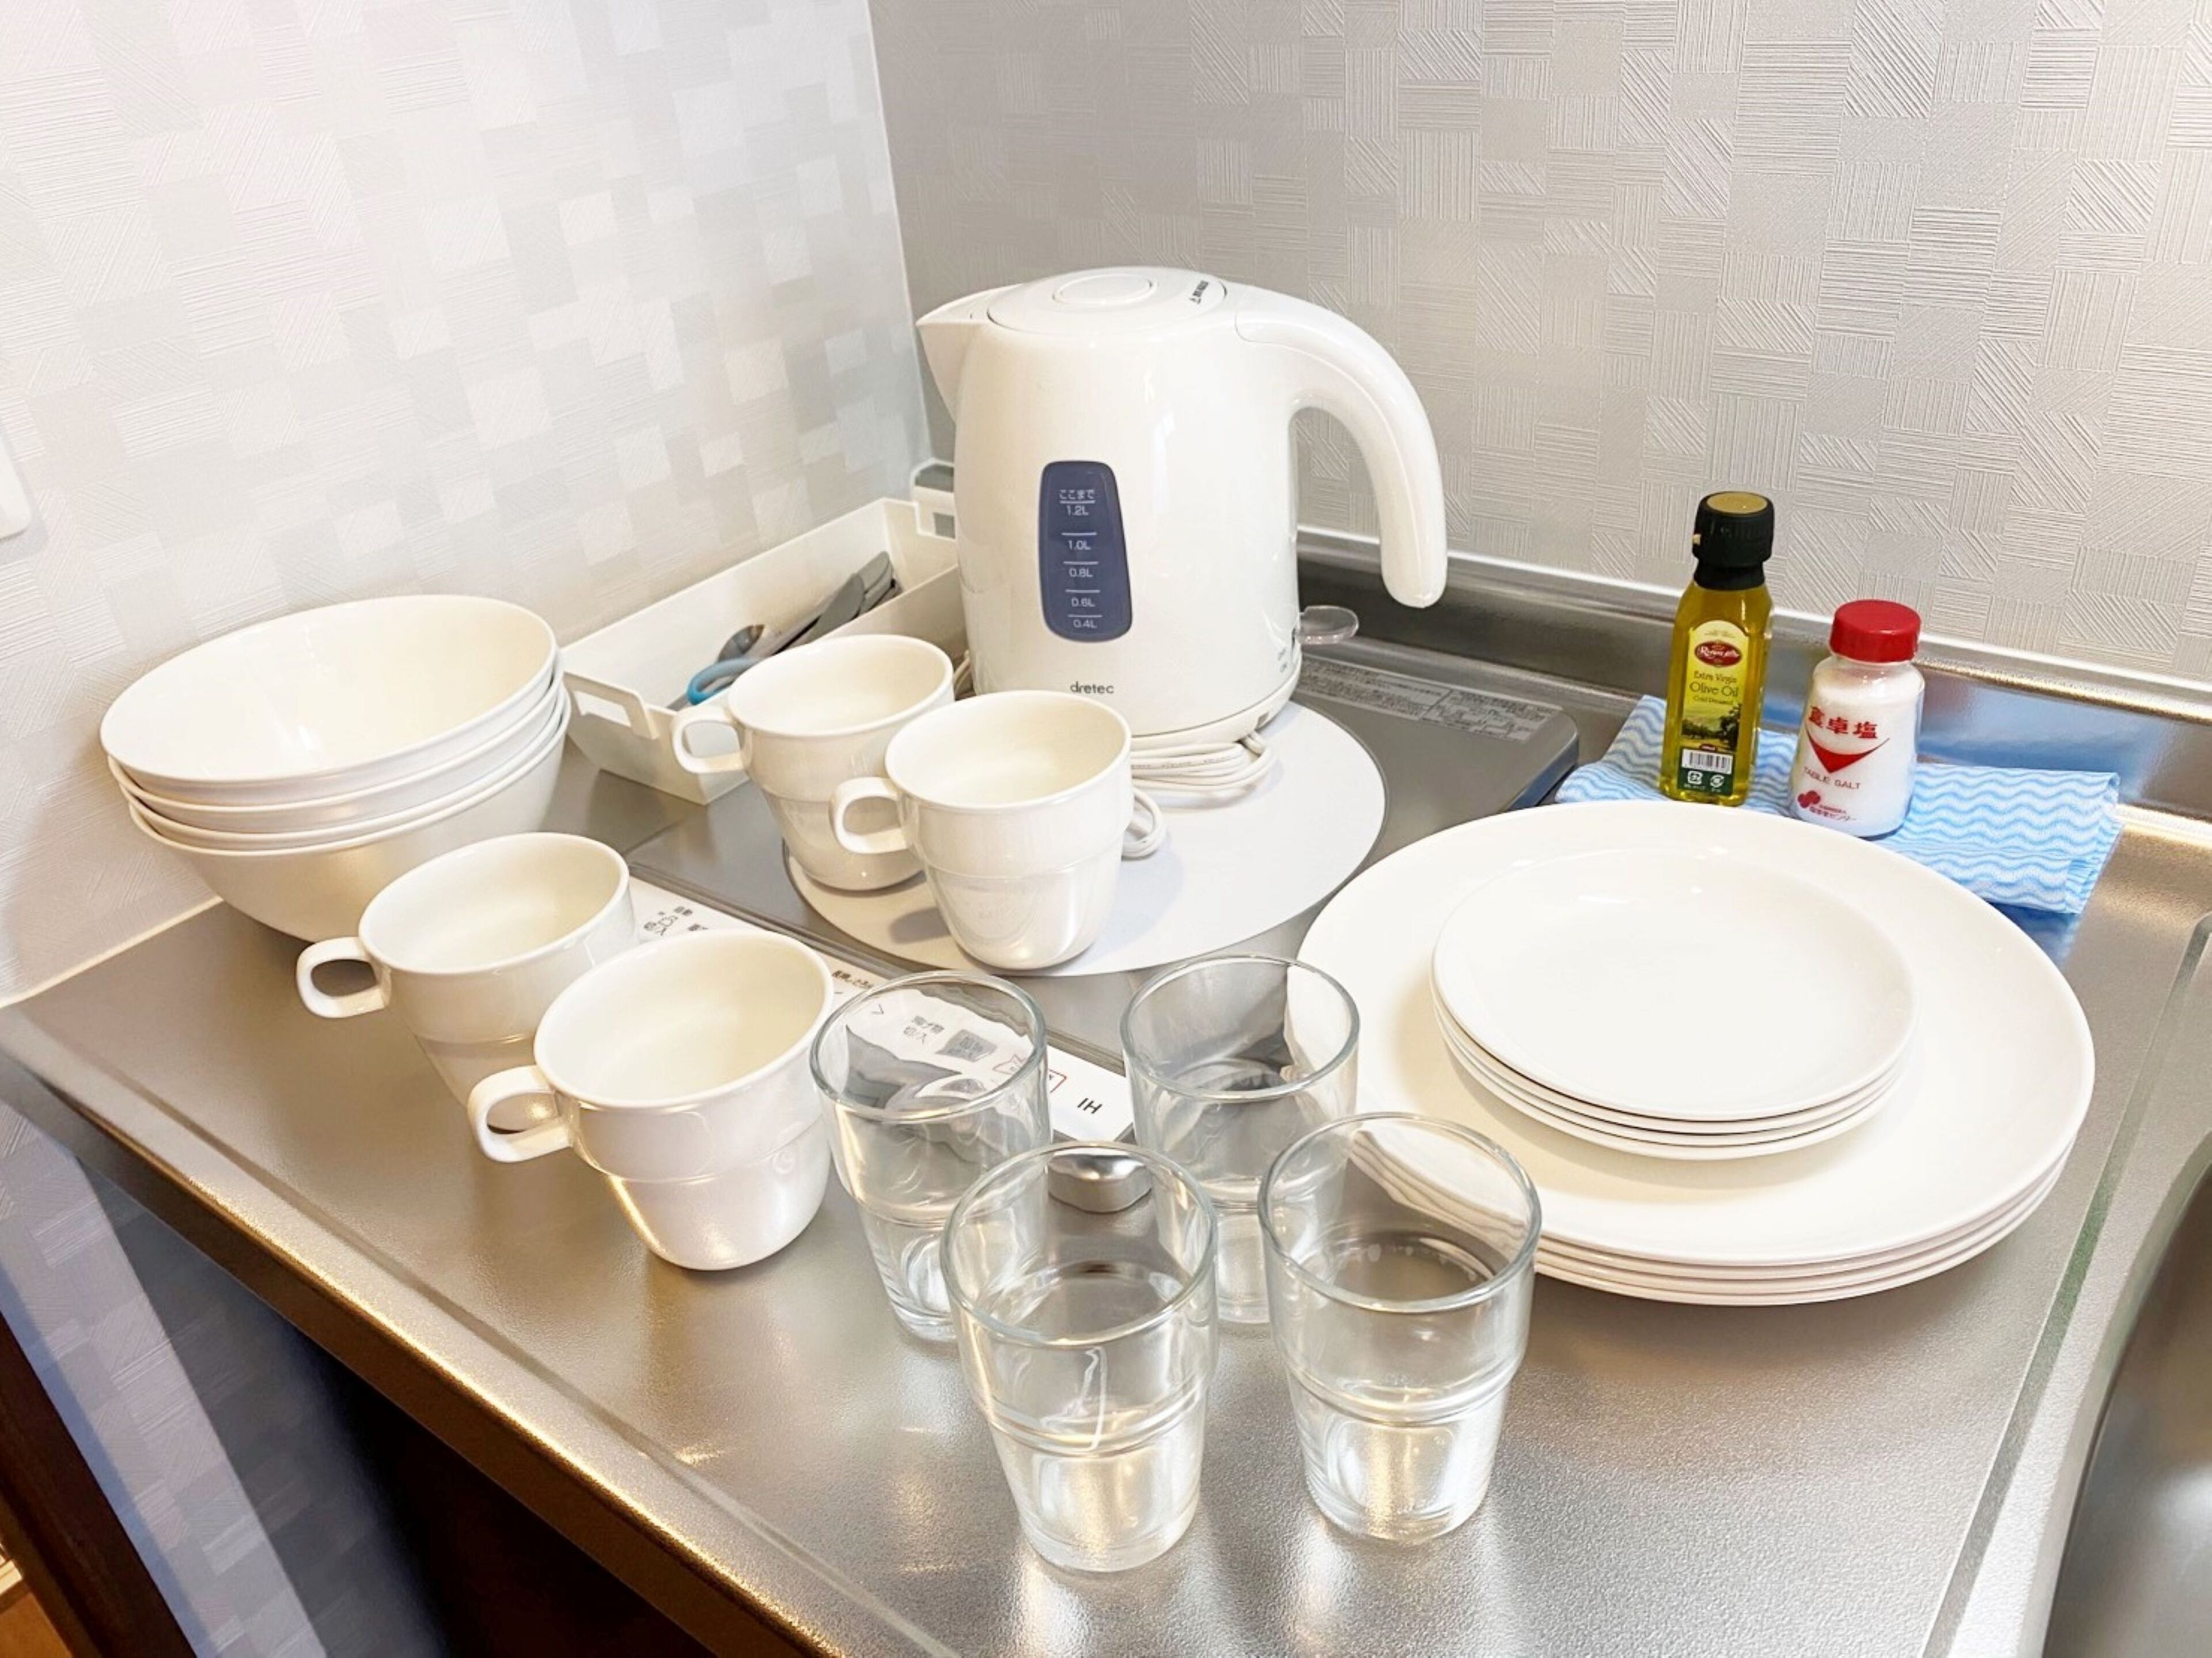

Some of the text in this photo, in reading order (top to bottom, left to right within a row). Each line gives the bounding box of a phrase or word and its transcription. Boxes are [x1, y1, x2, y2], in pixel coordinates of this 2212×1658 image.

[1060, 489, 1095, 499] ここまで
[1066, 505, 1089, 516] 1.2L
[1068, 540, 1092, 551] 1.0L
[1069, 567, 1093, 578] 0.8L
[1071, 597, 1095, 607] 0.6L
[1073, 619, 1097, 629] 0.4L
[1693, 670, 1737, 685] Extra Virgin
[1070, 681, 1114, 695] dretec
[1689, 681, 1739, 697] Olive Oil
[1804, 766, 1861, 790] TABLE SALT
[1077, 1098, 1102, 1114] IH
